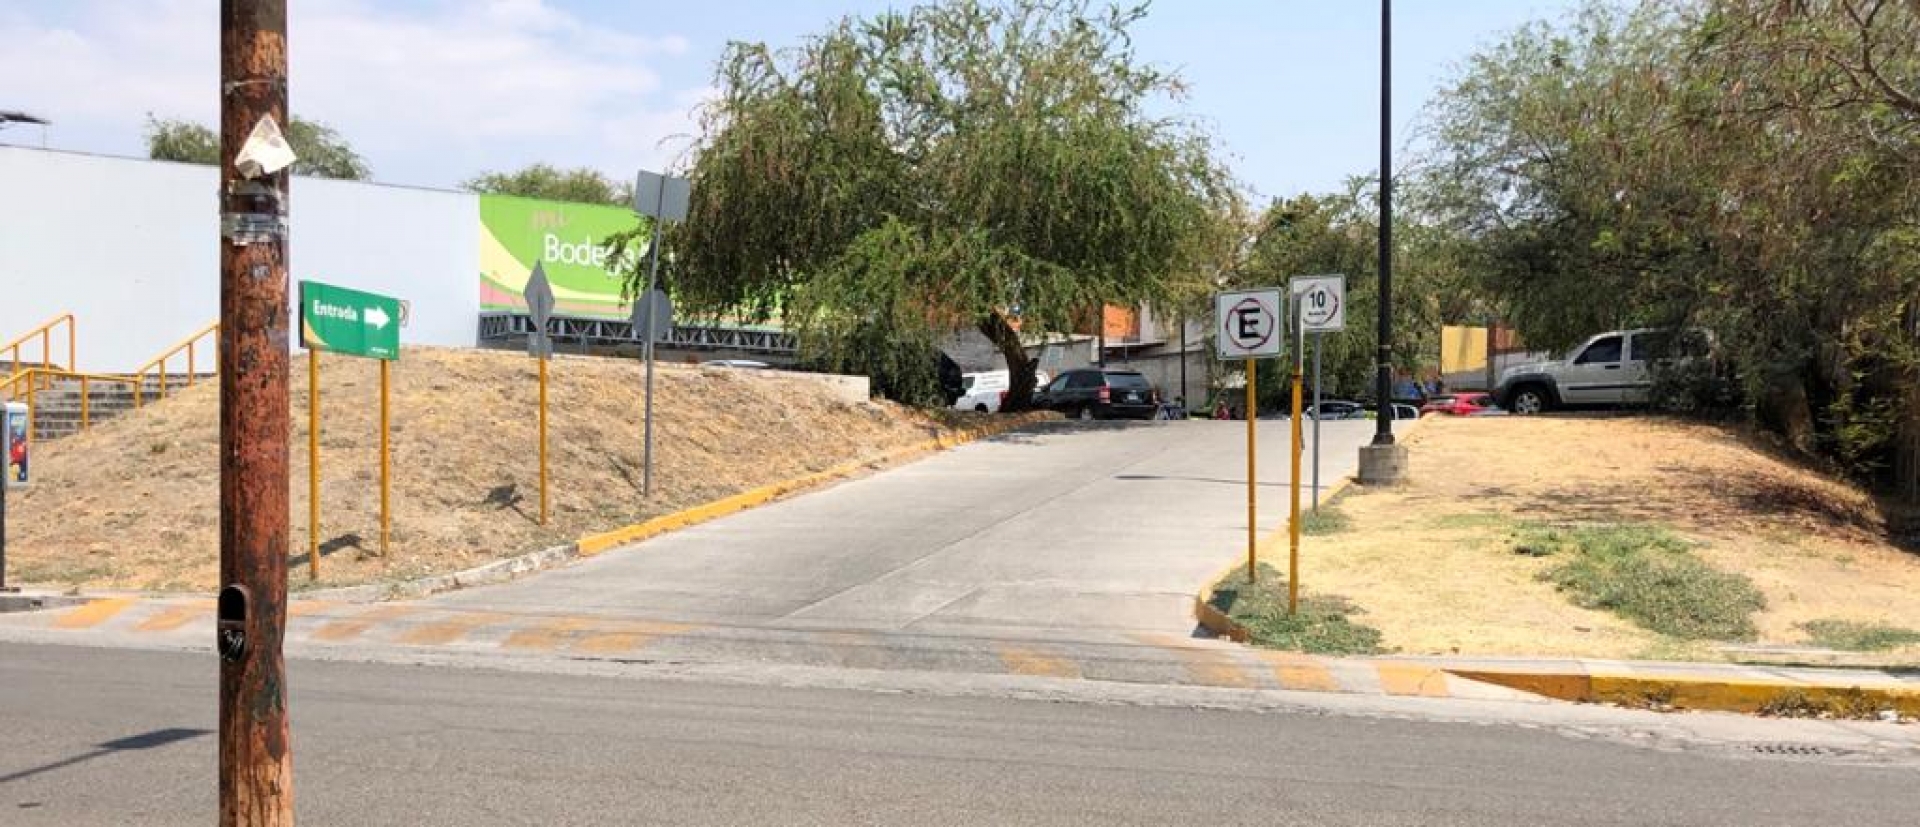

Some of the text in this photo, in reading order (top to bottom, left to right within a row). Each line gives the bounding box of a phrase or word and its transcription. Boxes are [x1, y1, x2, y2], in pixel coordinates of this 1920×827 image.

[313, 299, 358, 322] Entrada
[1308, 290, 1326, 308] 10
[1237, 307, 1261, 339] E
